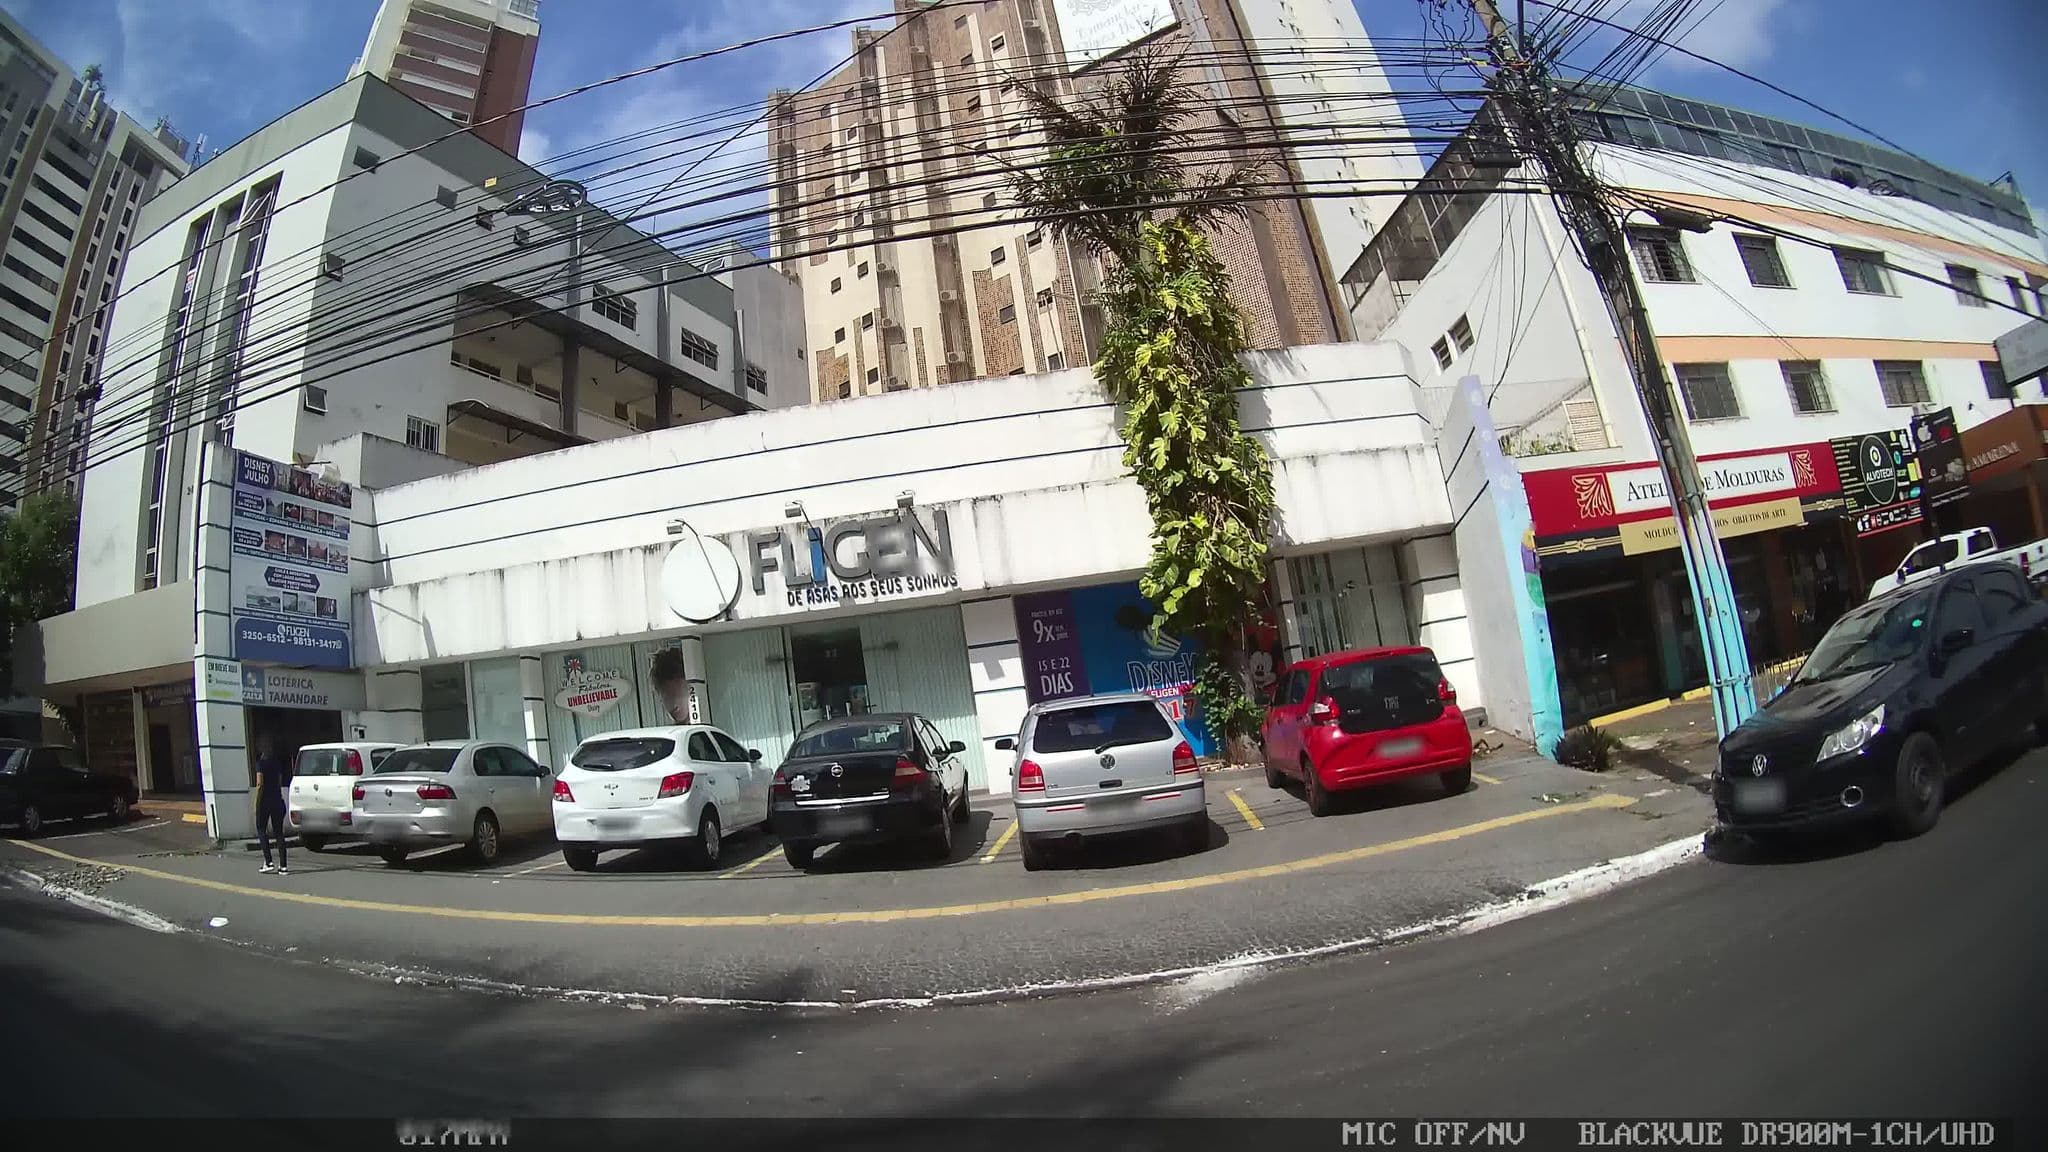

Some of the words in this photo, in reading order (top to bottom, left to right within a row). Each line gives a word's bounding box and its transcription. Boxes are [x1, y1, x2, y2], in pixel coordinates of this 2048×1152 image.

[244, 457, 271, 473] DISNEY
[244, 470, 270, 485] JULHO
[1866, 468, 1893, 481] ALVOTECH
[1628, 481, 1668, 501] ATEL
[1714, 467, 1785, 489] MOLDURAS
[1644, 527, 1679, 539] MOLDUR
[787, 590, 803, 607] DE
[806, 585, 838, 605] ASAS
[842, 582, 867, 598] AOS
[871, 577, 903, 596] SEUS
[907, 573, 958, 592] SONHOS
[242, 631, 285, 643] 3250-6512
[1051, 659, 1057, 670] E
[1060, 657, 1071, 668] 22
[560, 670, 617, 688] WELCOME
[1127, 653, 1197, 693] DISNEY
[1041, 672, 1074, 696] DIAS
[567, 688, 618, 707] UNBELIEVABLE
